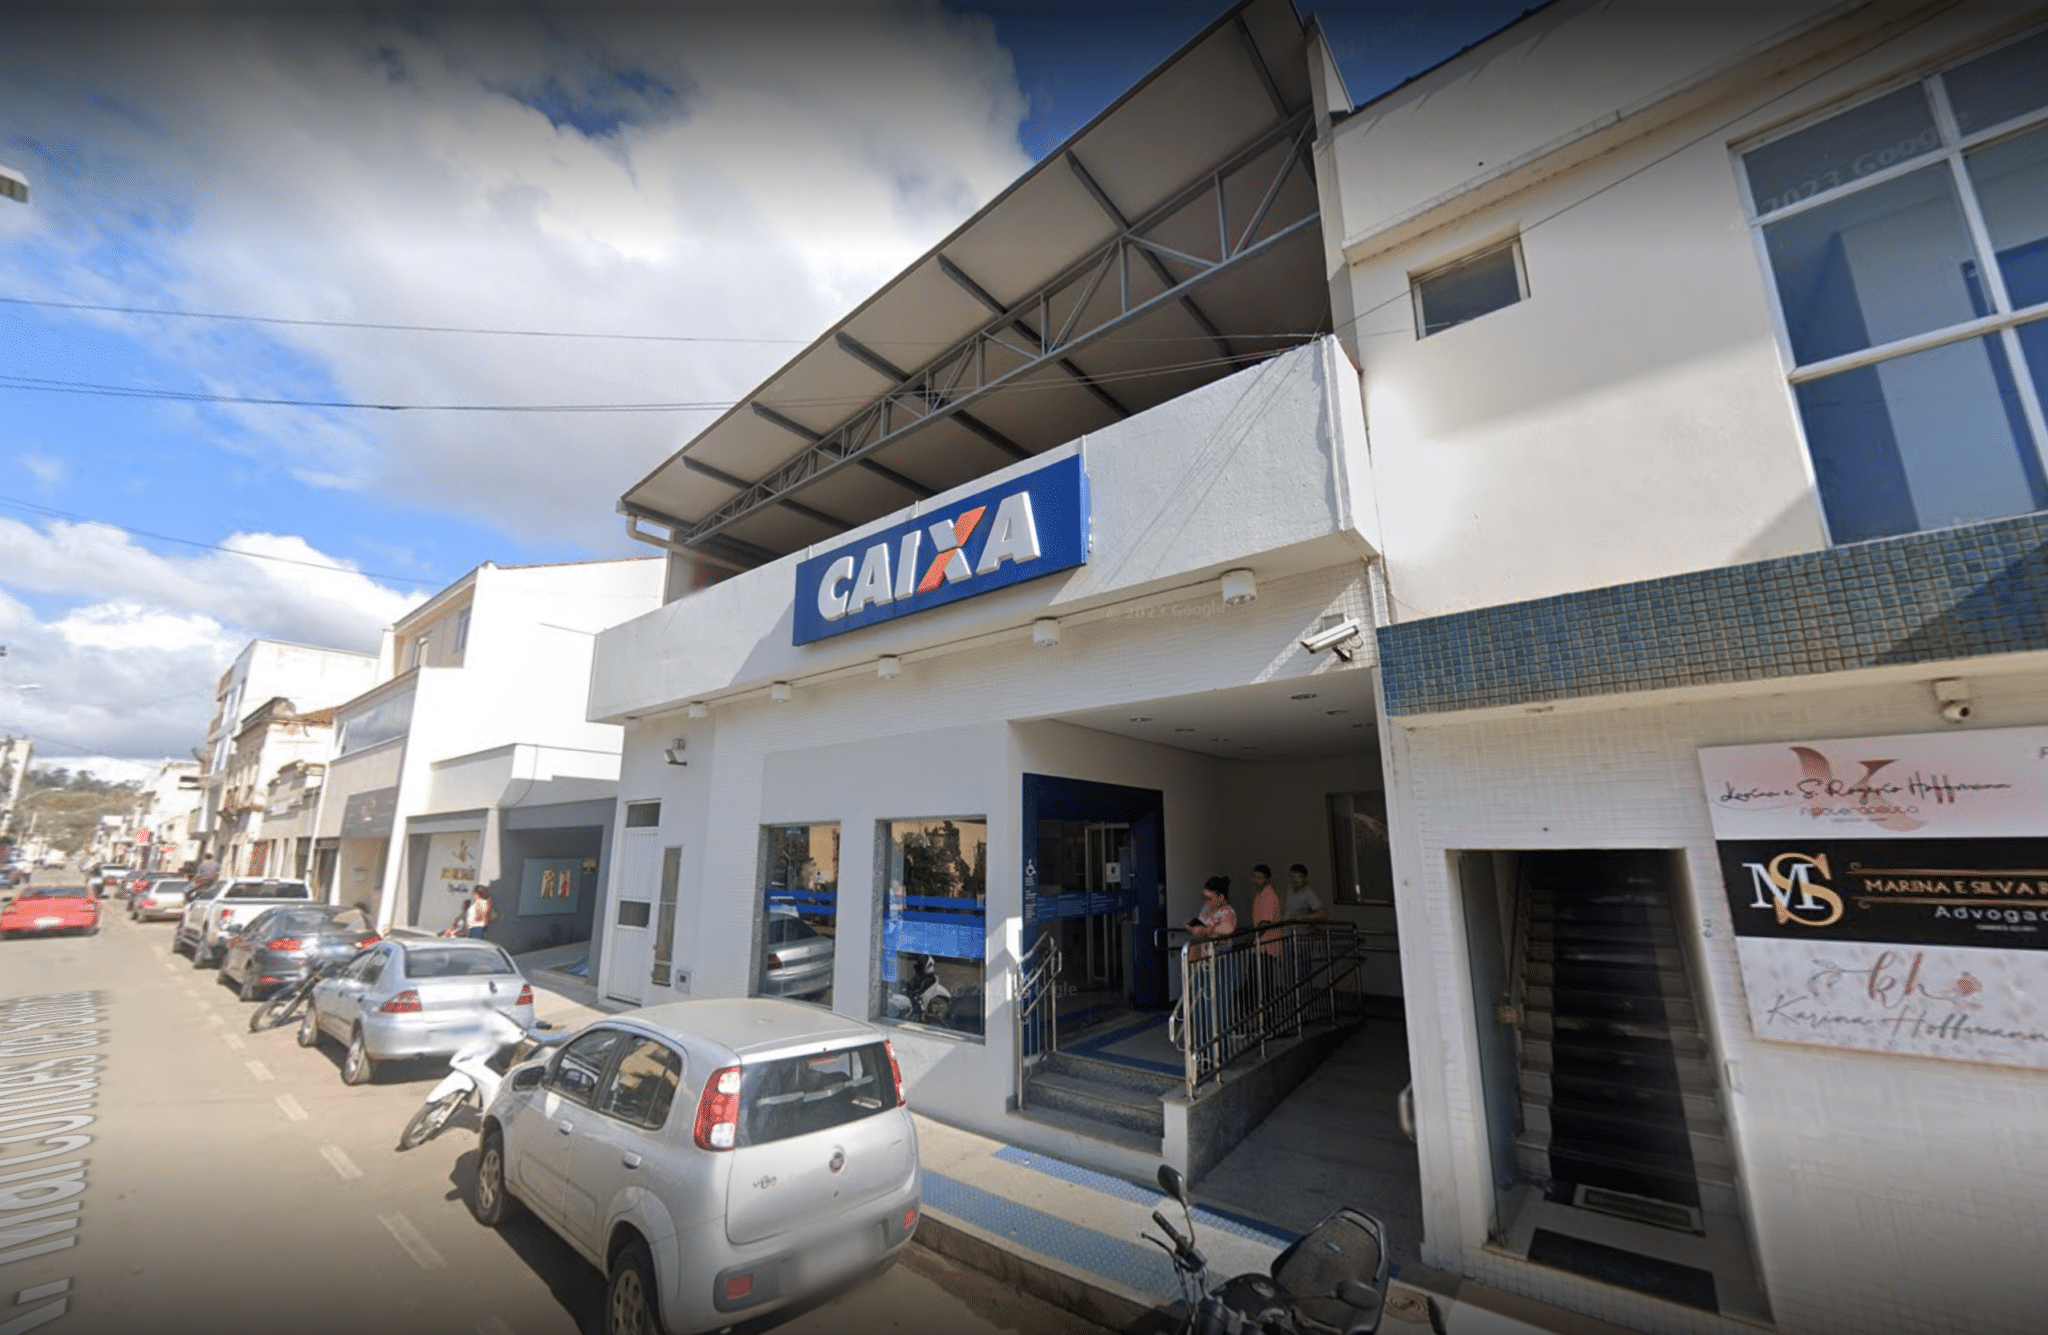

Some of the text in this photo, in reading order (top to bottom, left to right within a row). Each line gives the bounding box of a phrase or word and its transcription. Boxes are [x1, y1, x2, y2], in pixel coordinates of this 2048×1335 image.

[817, 490, 1041, 622] CAIXA
[1864, 878, 1950, 894] MARINA
[1969, 880, 2035, 896] SILVA
